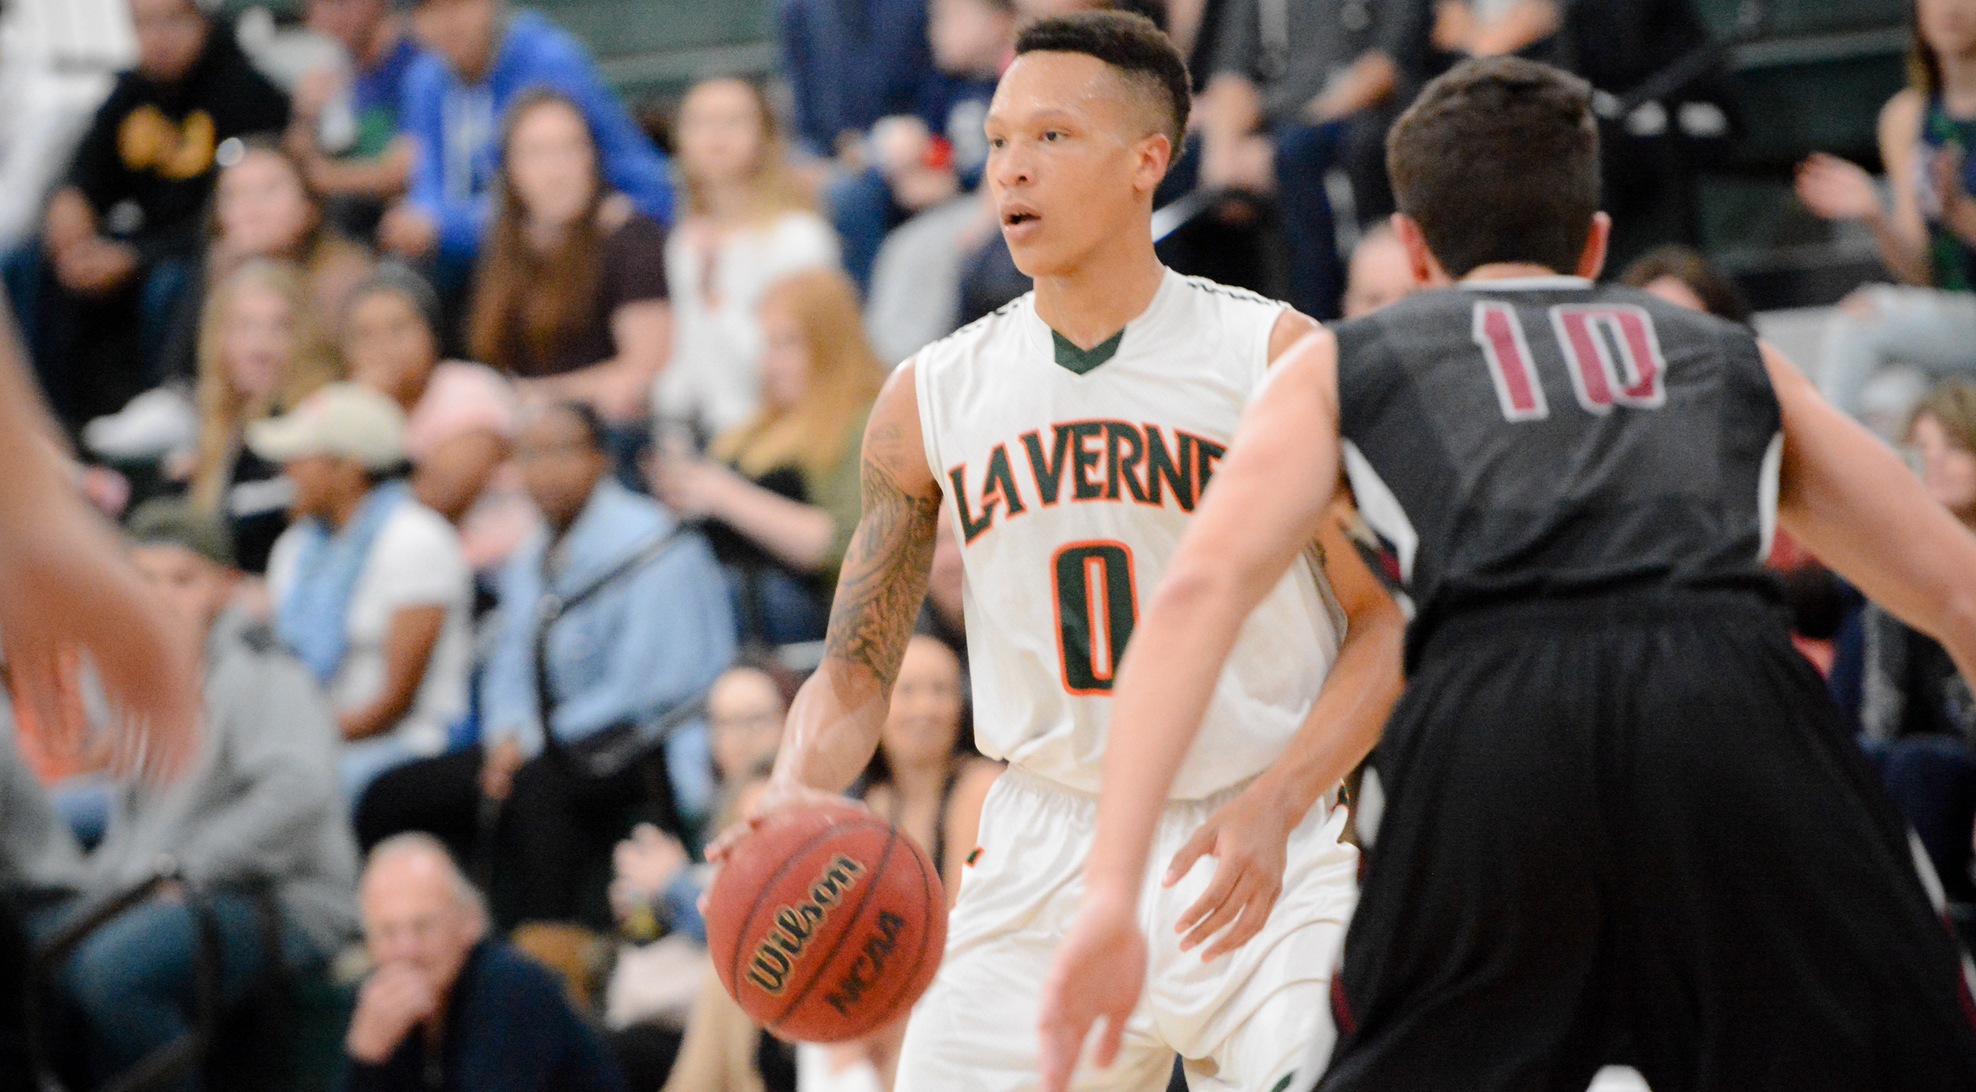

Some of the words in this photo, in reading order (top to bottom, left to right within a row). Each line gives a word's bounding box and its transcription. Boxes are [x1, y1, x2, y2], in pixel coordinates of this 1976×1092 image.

[1471, 301, 1667, 423] 10
[948, 440, 1027, 547] LA
[1050, 538, 1140, 696] 0
[745, 853, 867, 997] Wilson
[824, 909, 906, 1018] NCAA
